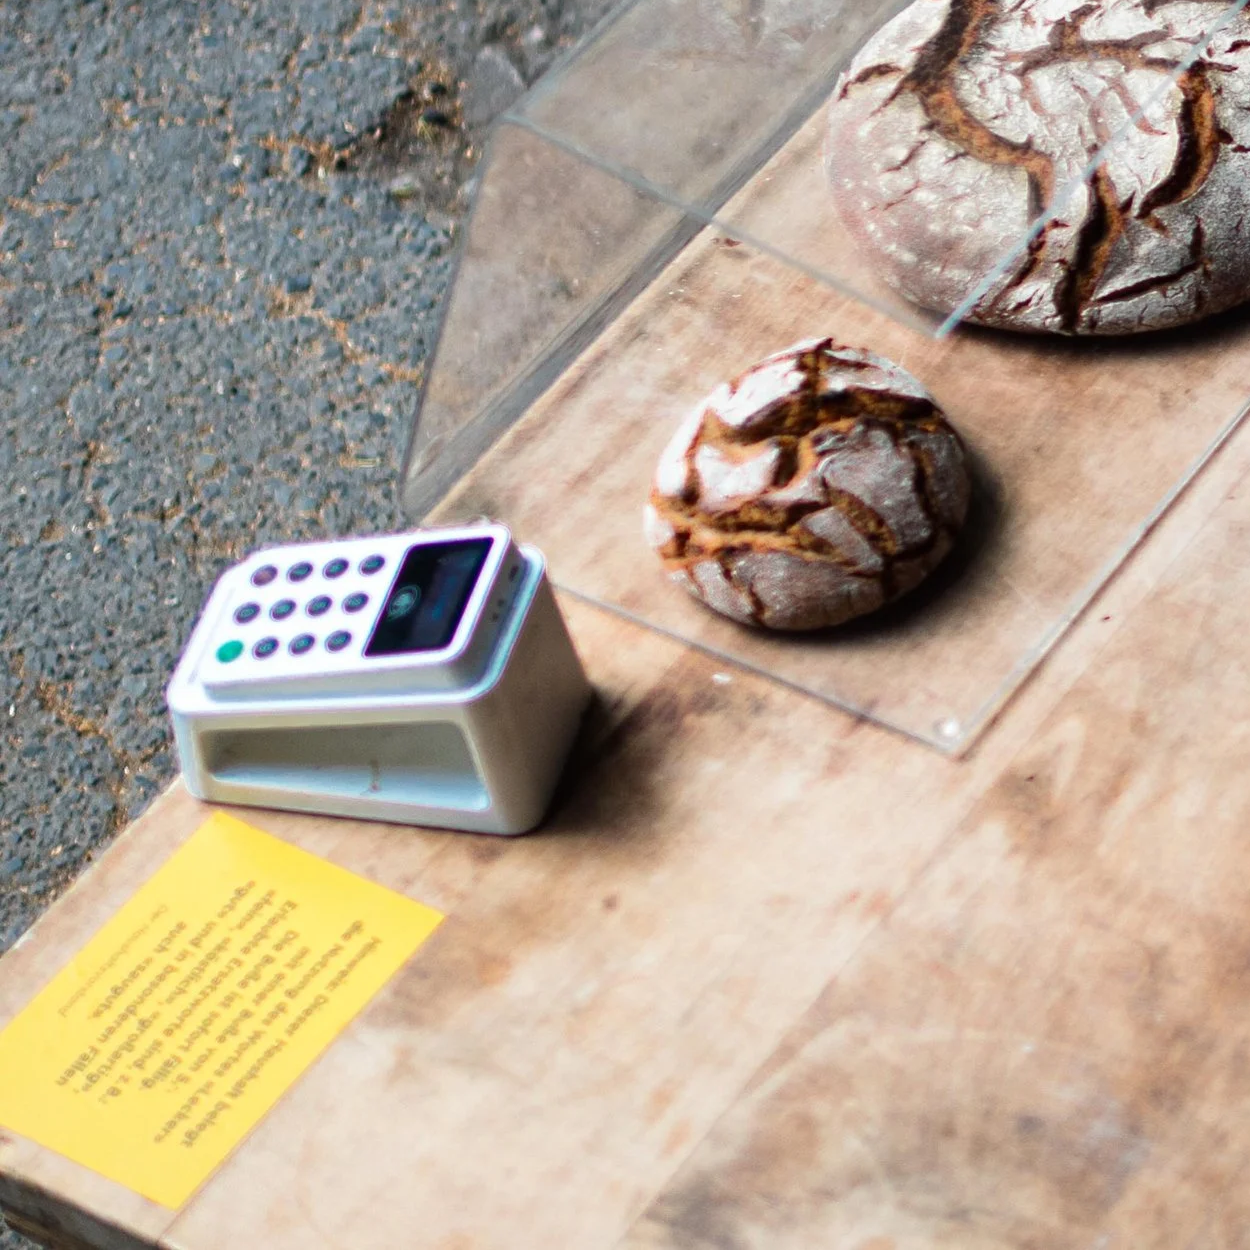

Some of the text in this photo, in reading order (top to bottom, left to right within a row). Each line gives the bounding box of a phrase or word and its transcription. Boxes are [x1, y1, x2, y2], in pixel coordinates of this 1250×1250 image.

[151, 920, 193, 956] auch
[186, 919, 222, 949] und
[238, 899, 298, 957] Erlaubte
[270, 928, 301, 954] Die
[338, 918, 368, 943] die
[172, 947, 196, 964] in
[235, 953, 278, 991] Buße
[282, 941, 345, 1001] Nutzung
[283, 945, 314, 971] mit
[95, 962, 180, 1045] besonderen
[160, 956, 244, 1038] Ersatzworte
[216, 990, 243, 1011] ist
[249, 971, 289, 1007] einer
[176, 1010, 224, 1054] sofort
[214, 1007, 256, 1046] Buße
[260, 1000, 292, 1028] des
[282, 992, 331, 1037] Dieser
[187, 1045, 217, 1073] von
[212, 1027, 266, 1079] Wortes
[224, 1037, 289, 1100] Haushalt
[176, 1098, 232, 1150] belegt
